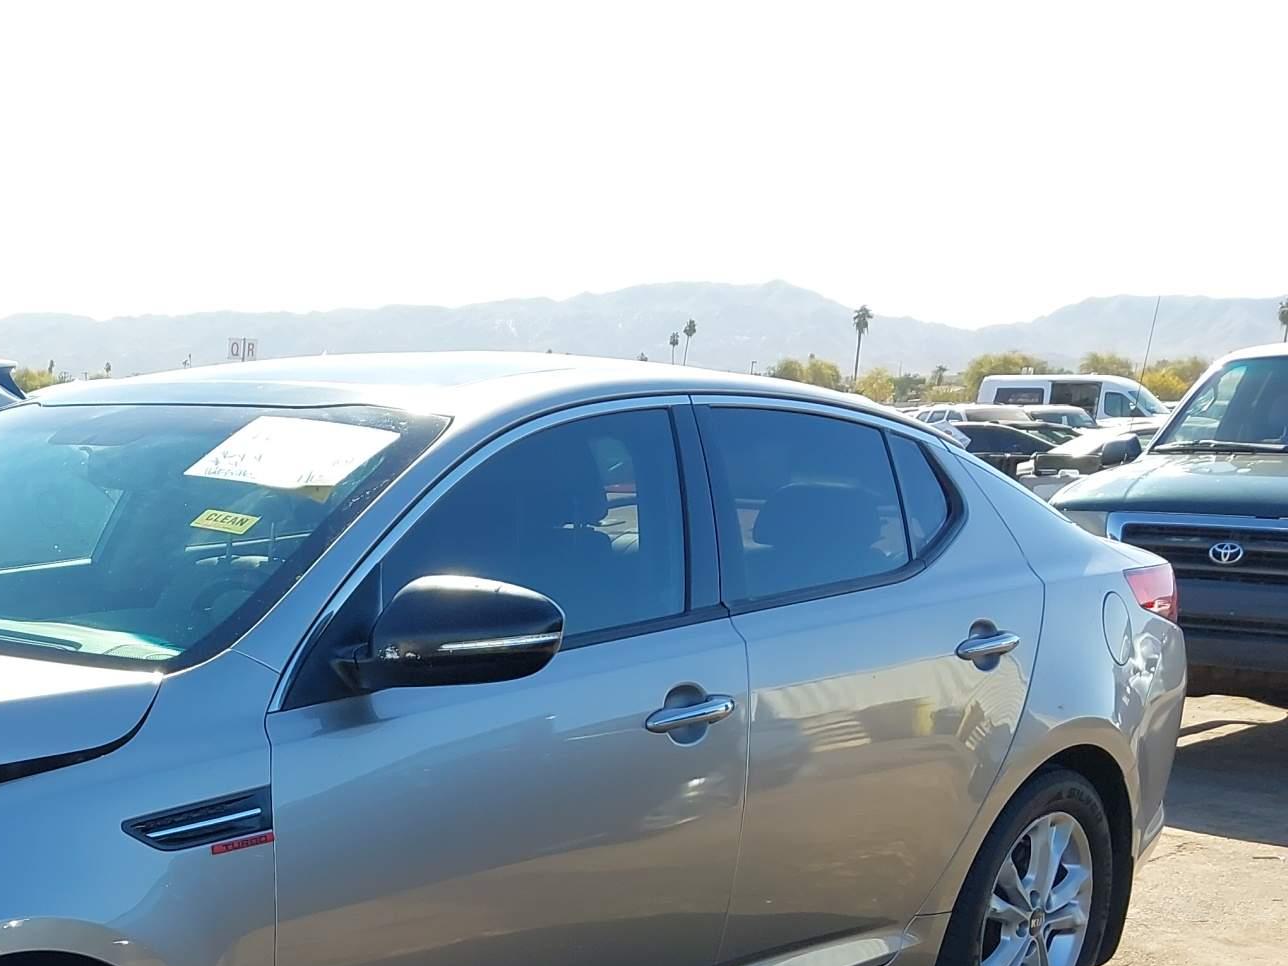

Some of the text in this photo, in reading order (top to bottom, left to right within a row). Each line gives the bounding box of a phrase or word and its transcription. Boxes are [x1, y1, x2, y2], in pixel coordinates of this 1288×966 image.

[231, 342, 240, 357] Q
[247, 342, 255, 357] R
[206, 512, 249, 526] CLEAN
